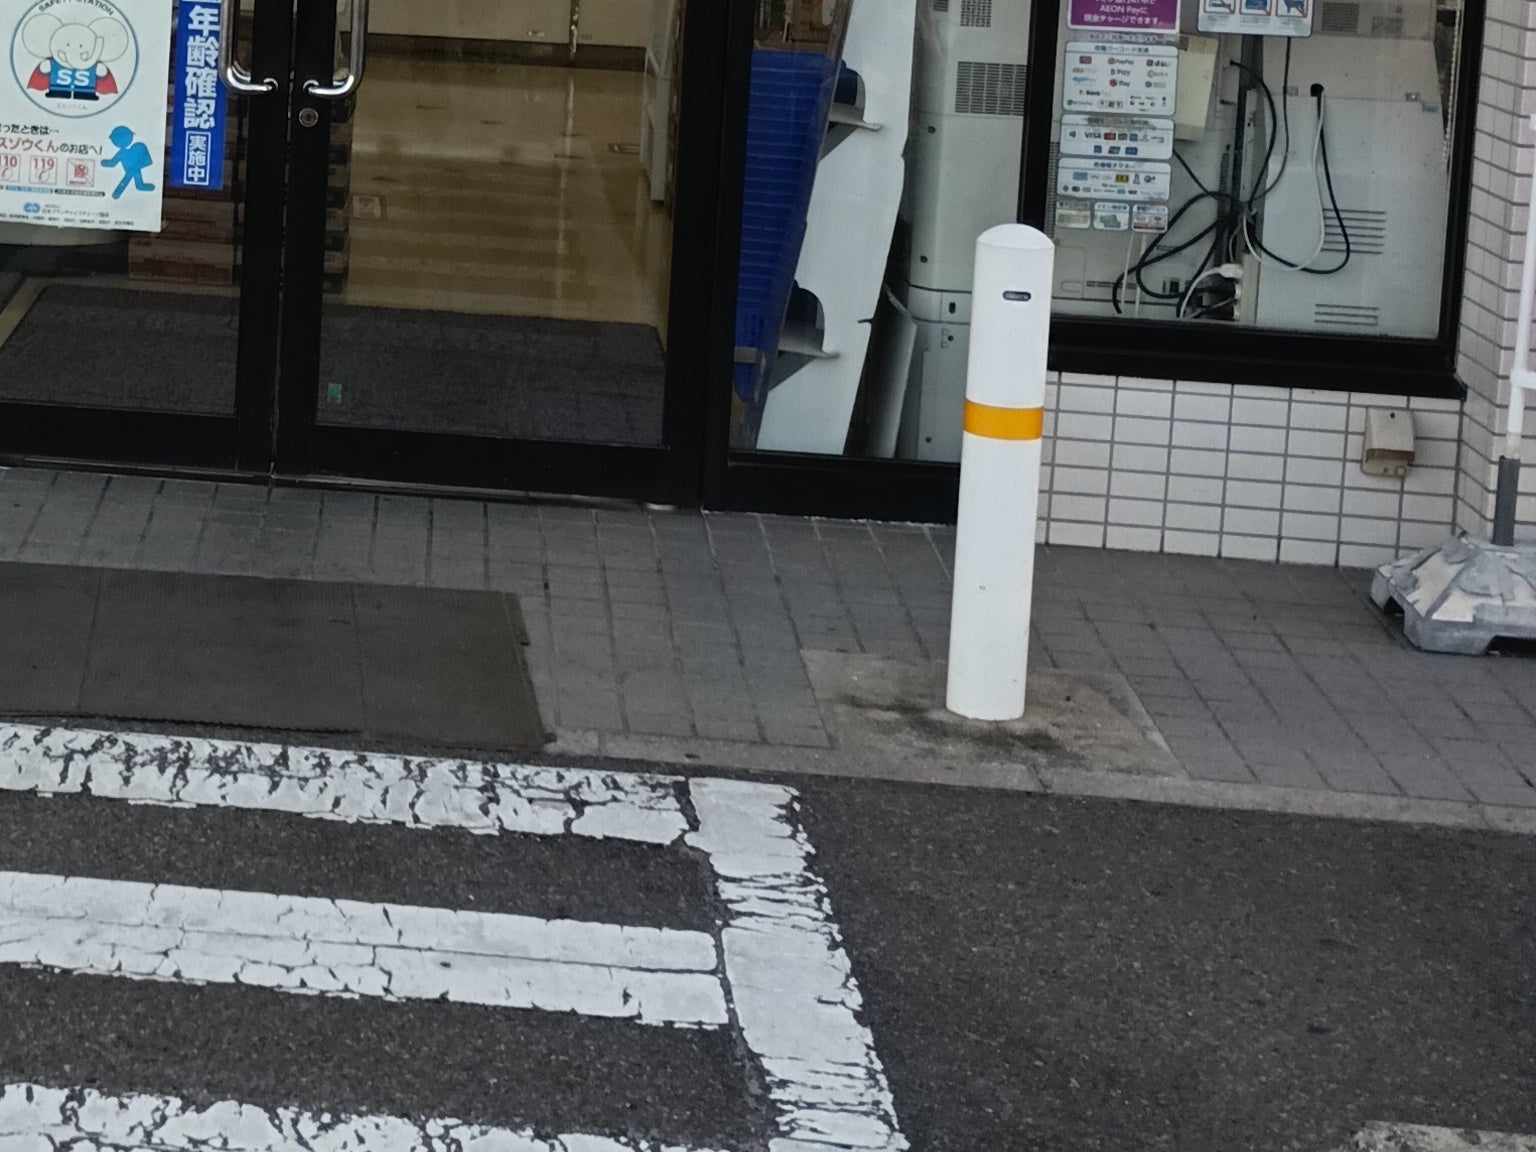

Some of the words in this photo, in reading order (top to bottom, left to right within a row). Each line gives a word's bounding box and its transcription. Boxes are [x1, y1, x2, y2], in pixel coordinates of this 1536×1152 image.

[183, 4, 221, 130] 年齢確認
[56, 70, 90, 86] SS
[32, 158, 55, 171] 119
